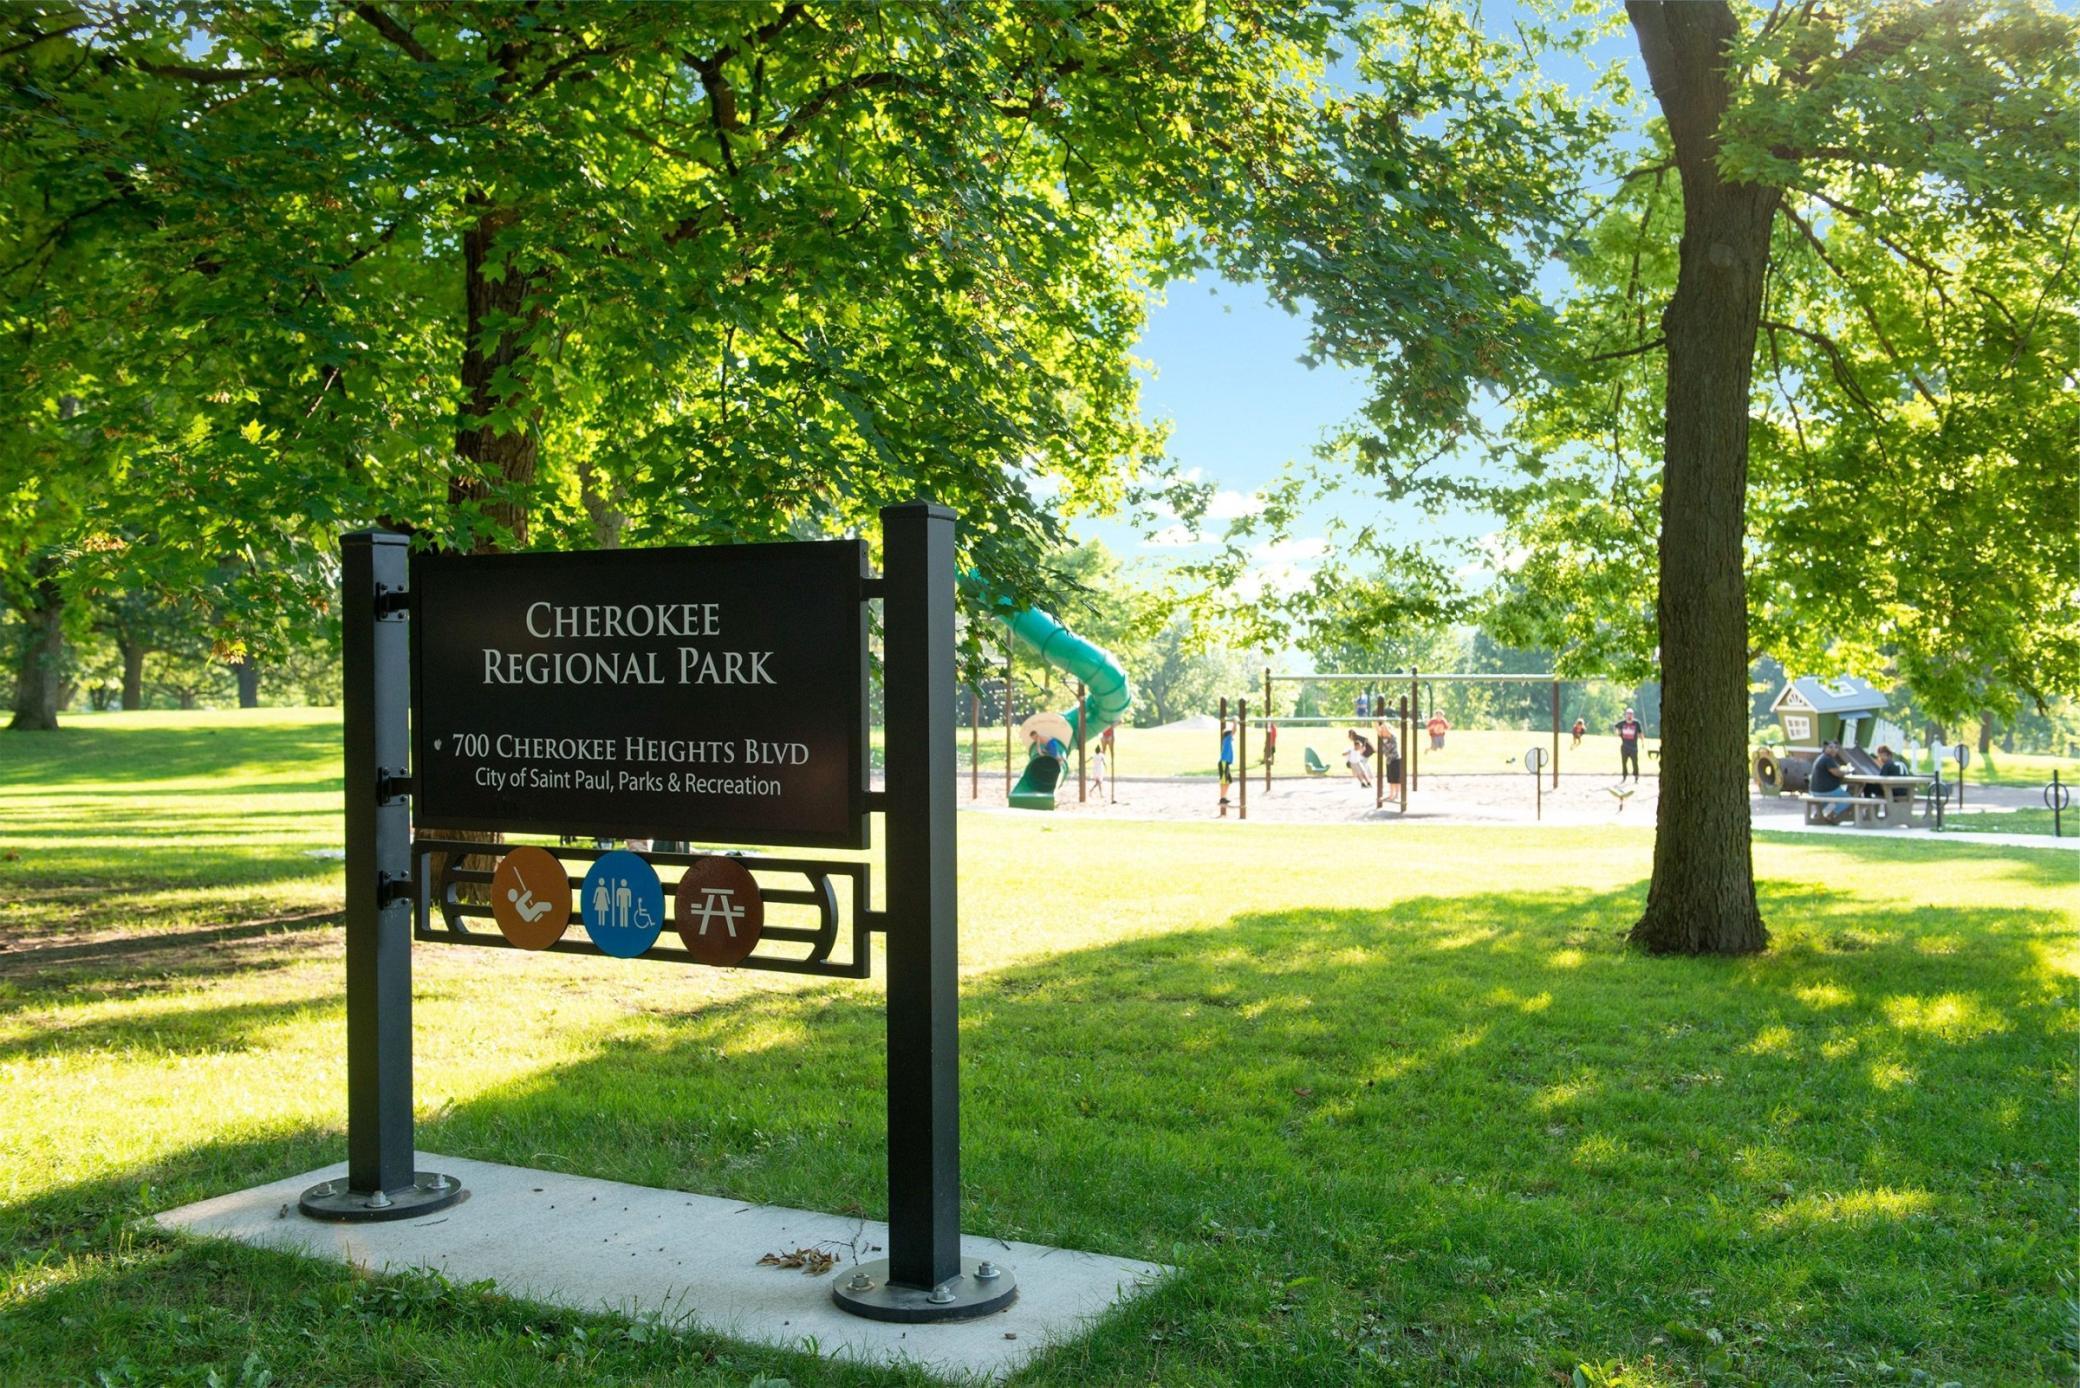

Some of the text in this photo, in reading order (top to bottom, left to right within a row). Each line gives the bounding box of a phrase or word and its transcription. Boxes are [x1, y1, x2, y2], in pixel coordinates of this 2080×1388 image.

[452, 733, 490, 757] 700
[475, 766, 781, 796] City of Saint Paul, Parks & Recreation
